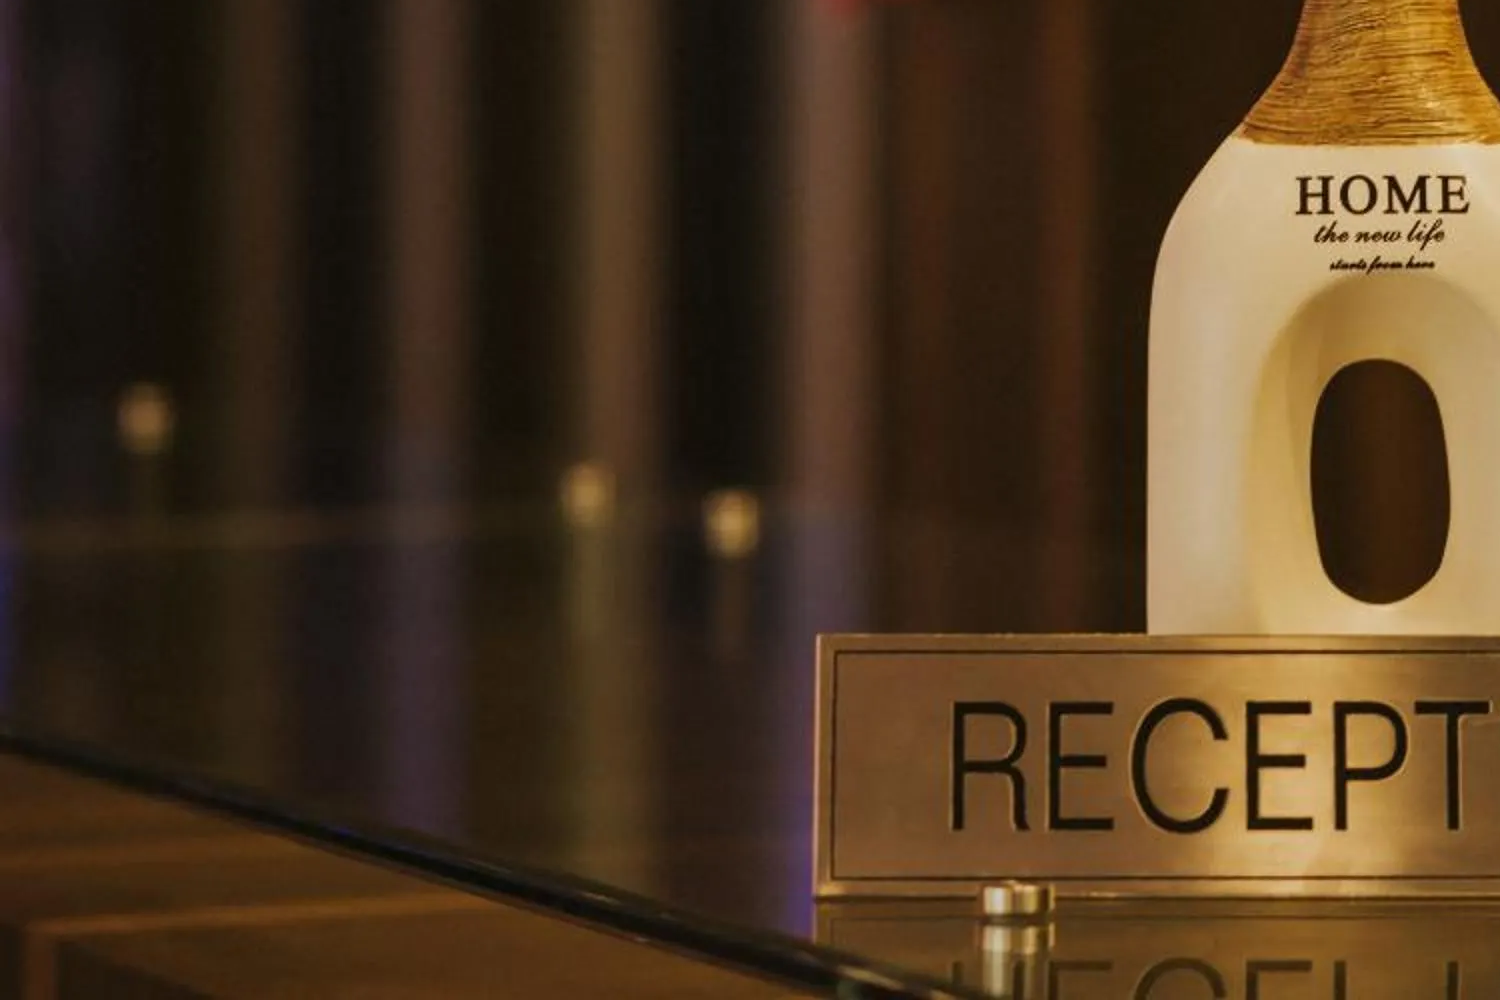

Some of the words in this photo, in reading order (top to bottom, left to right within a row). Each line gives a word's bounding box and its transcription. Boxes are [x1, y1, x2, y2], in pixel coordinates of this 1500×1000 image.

[1295, 174, 1470, 215] HOME
[1314, 220, 1350, 243] the
[1354, 230, 1403, 243] new
[1407, 218, 1445, 251] life
[1329, 257, 1367, 271] starts
[1366, 255, 1403, 275] from
[1405, 256, 1435, 270] here
